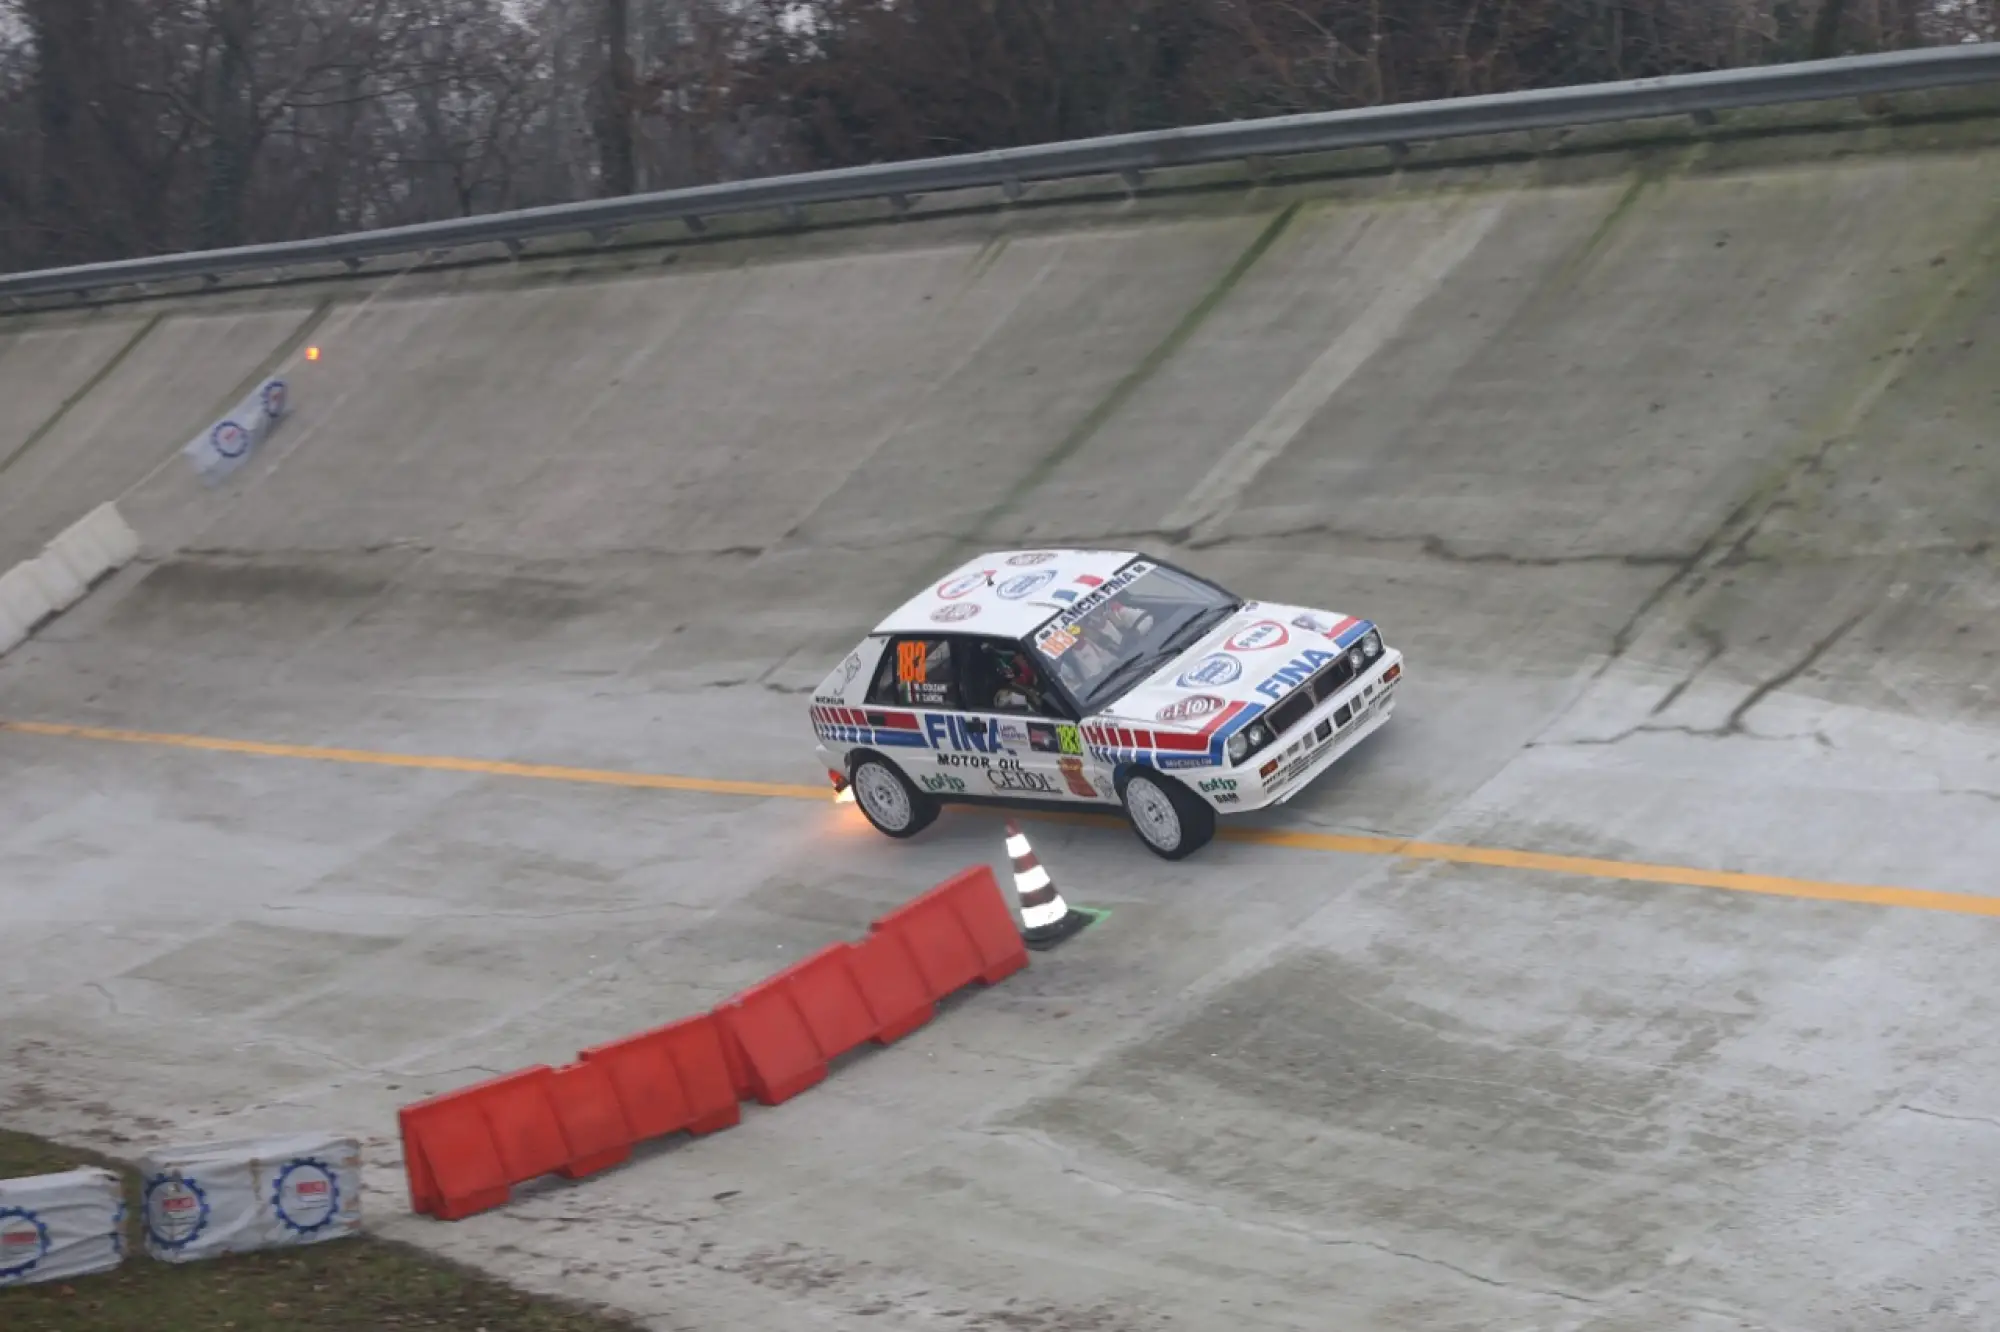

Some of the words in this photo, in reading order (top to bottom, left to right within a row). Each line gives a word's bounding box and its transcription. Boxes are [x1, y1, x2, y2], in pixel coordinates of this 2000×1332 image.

[897, 641, 926, 684] 183
[1255, 649, 1335, 701] FINA
[937, 752, 990, 769] MOTOR
[998, 758, 1025, 771] OIL
